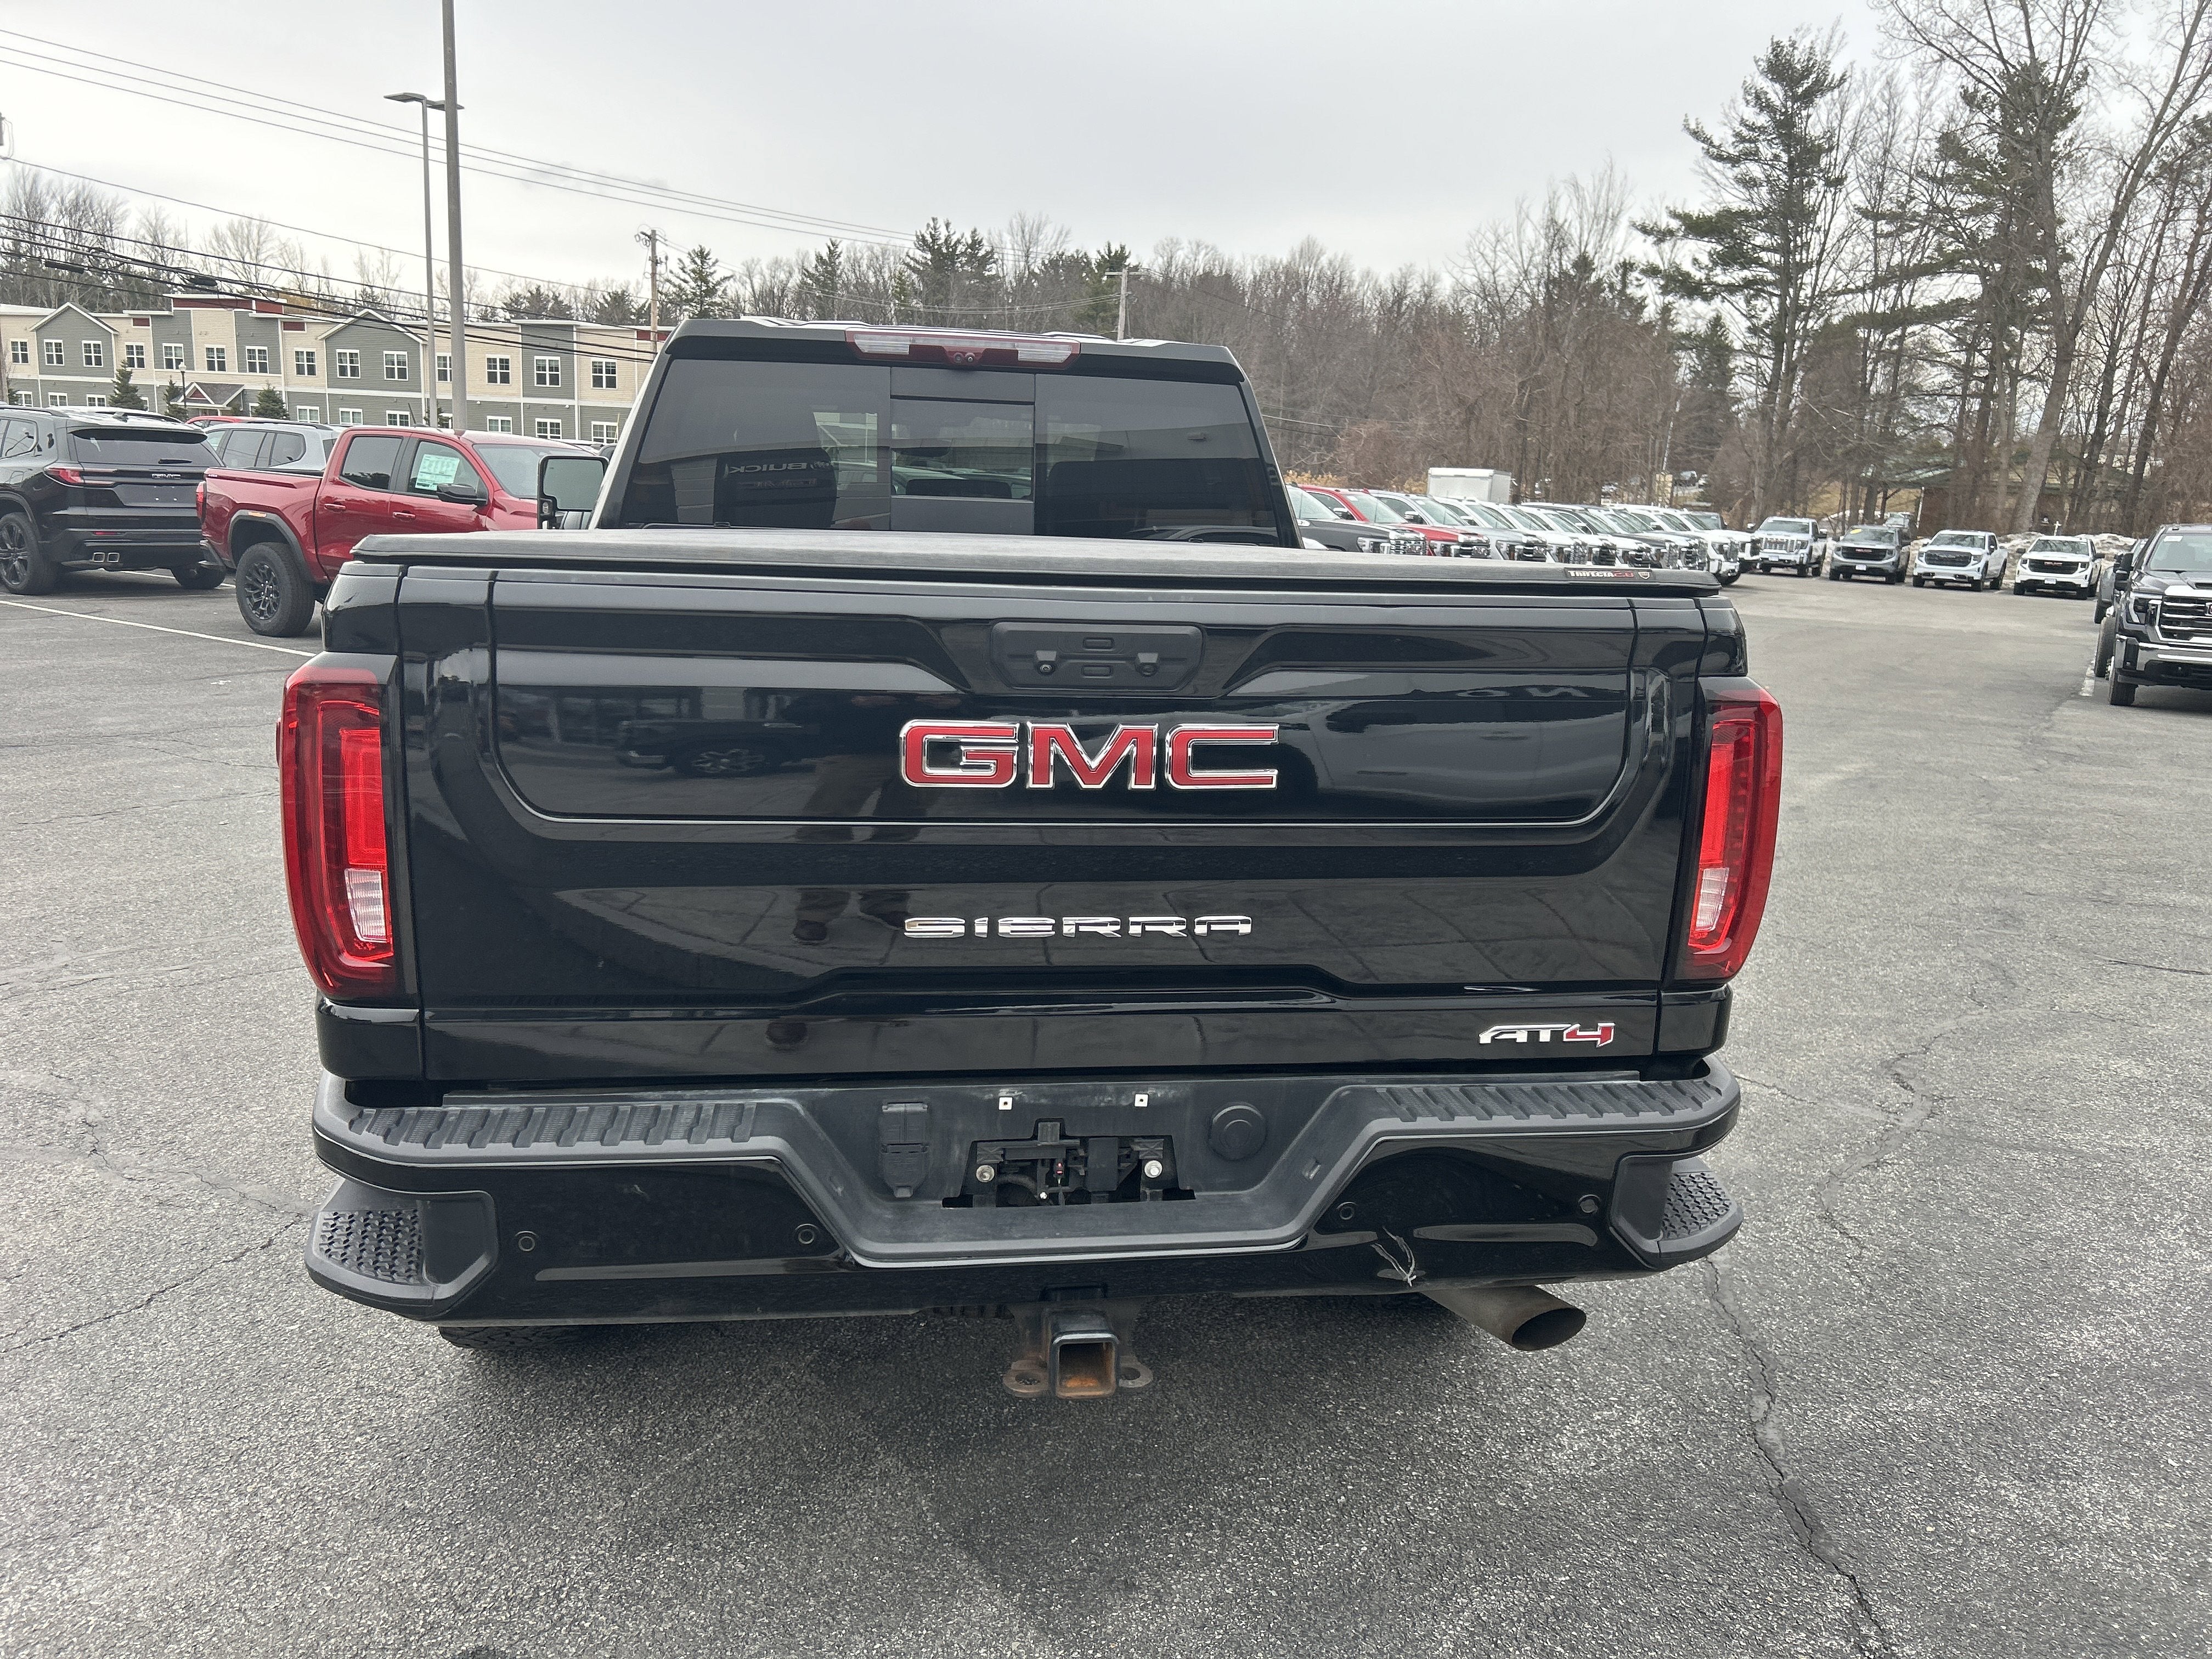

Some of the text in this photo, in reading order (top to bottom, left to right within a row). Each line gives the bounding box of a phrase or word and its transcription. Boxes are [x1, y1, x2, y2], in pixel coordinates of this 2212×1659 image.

[900, 720, 1280, 790] GMC
[904, 917, 1252, 939] SIERRA
[1479, 1023, 1616, 1048] AT4
